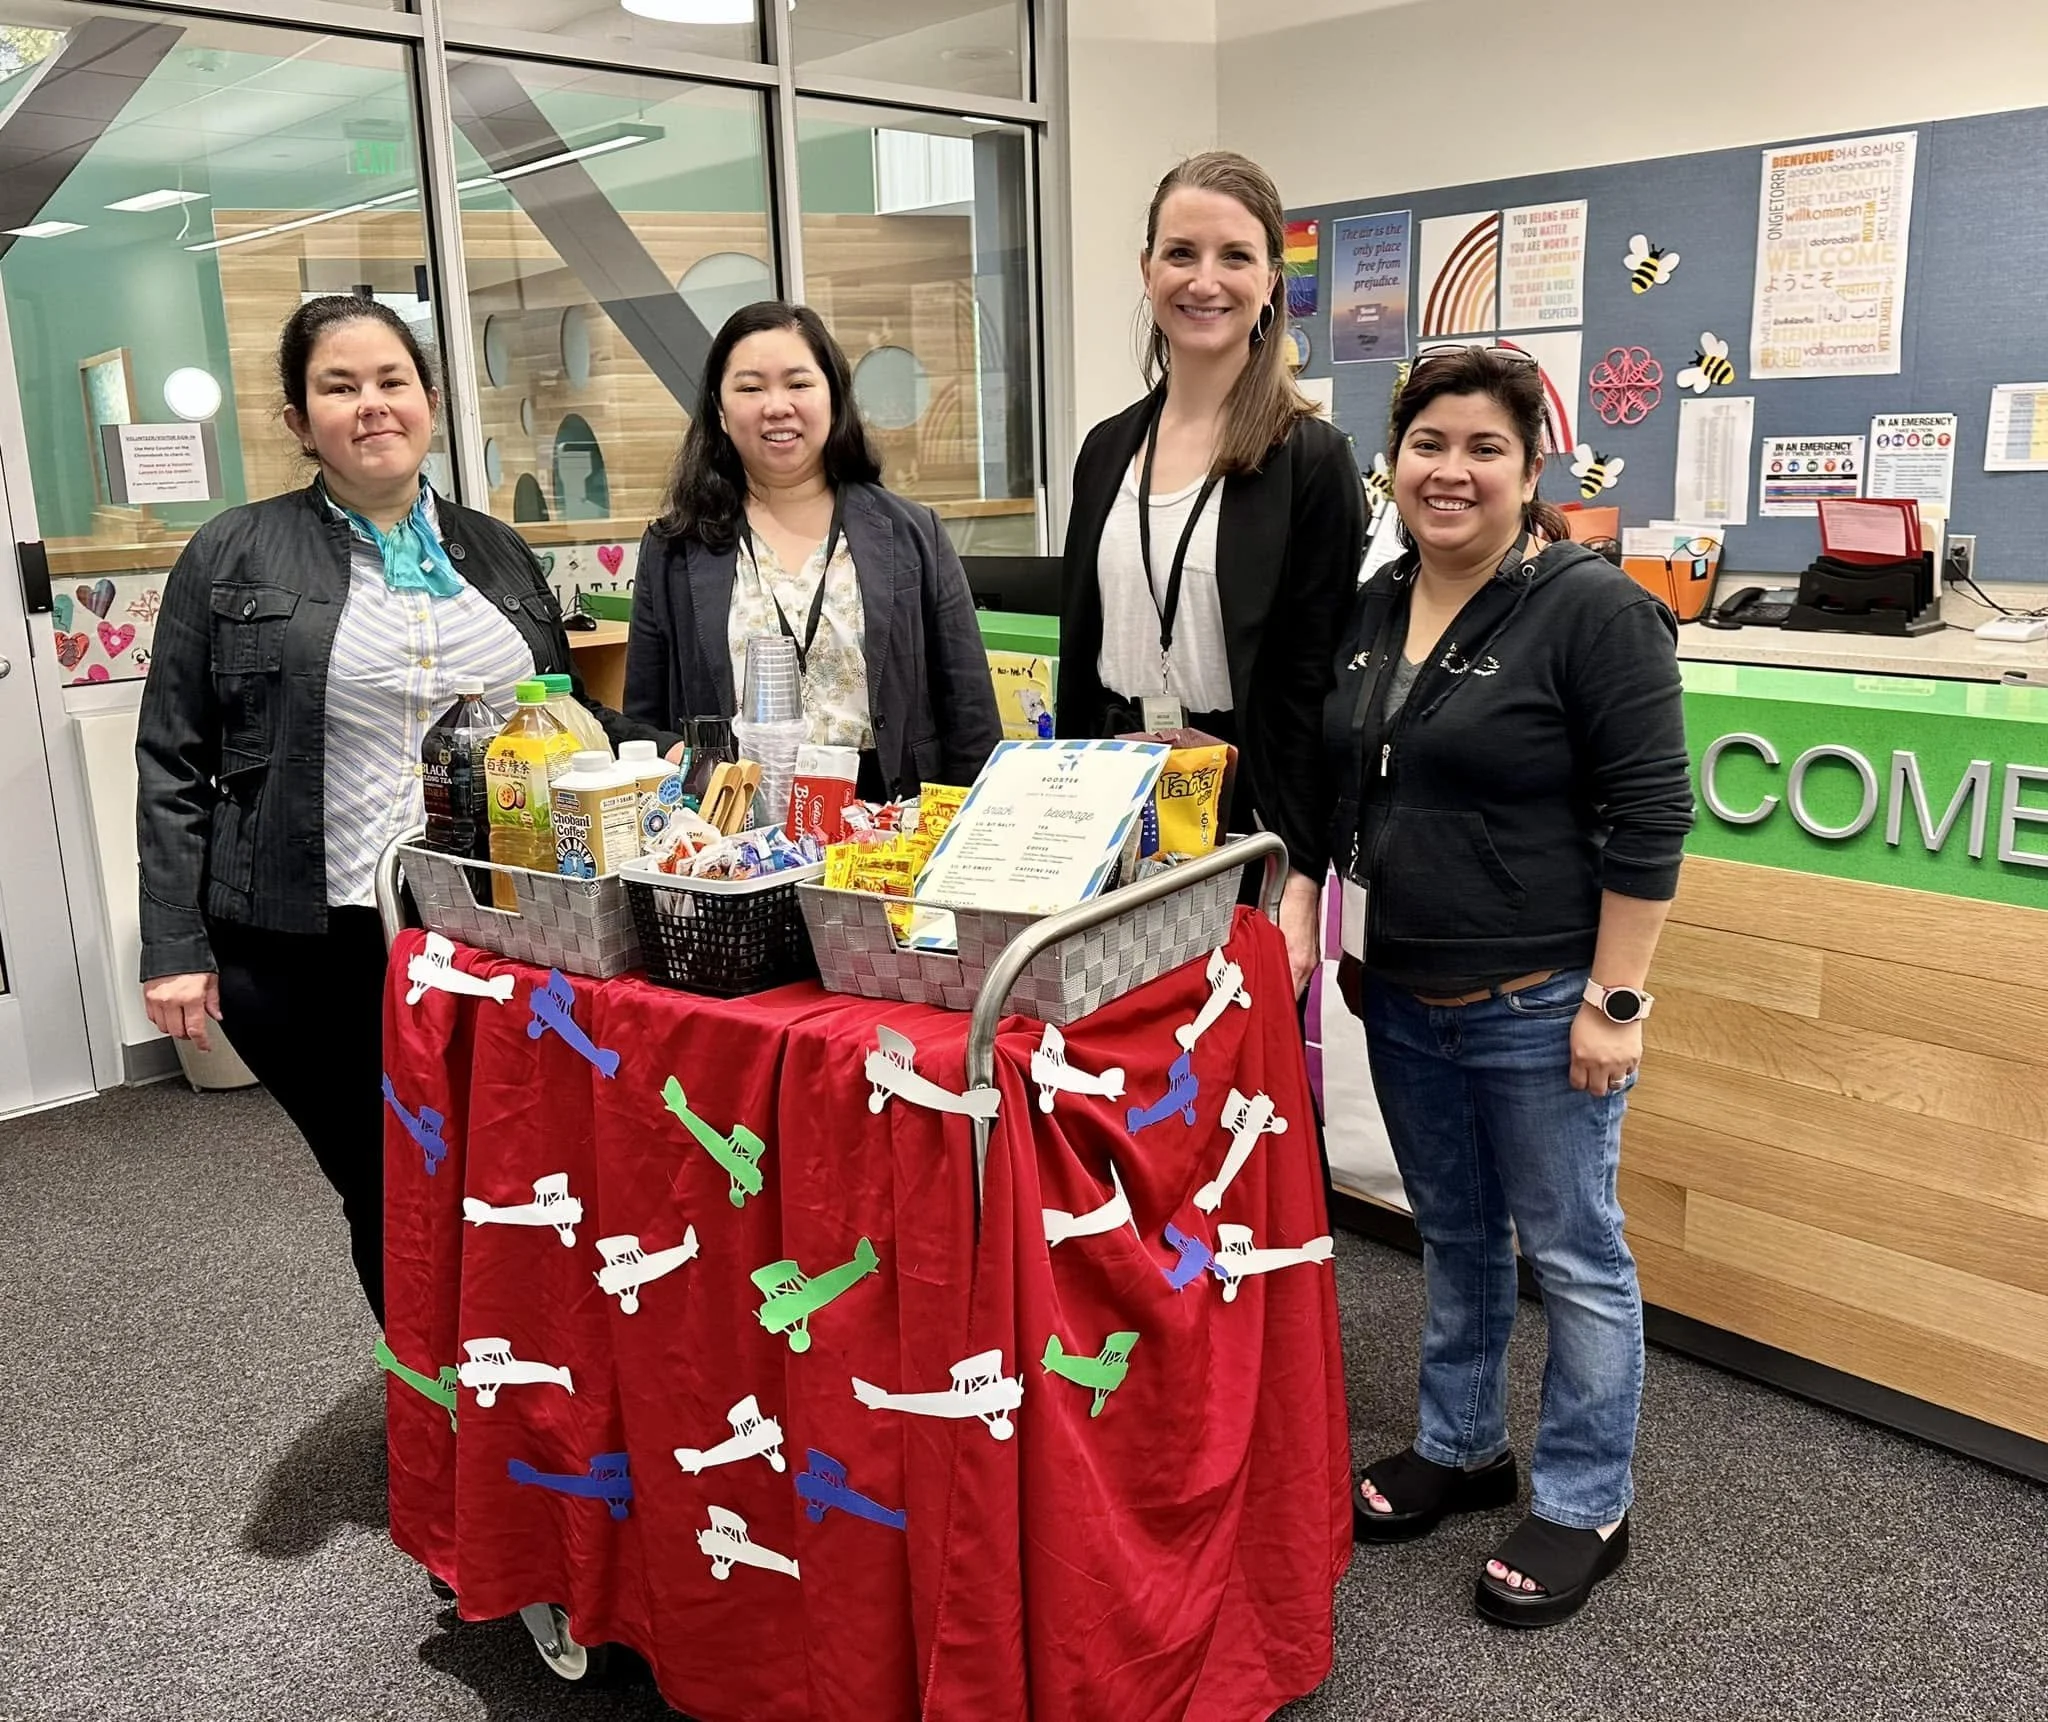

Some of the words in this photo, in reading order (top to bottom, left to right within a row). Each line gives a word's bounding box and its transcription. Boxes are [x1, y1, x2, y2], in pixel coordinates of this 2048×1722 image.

[356, 140, 396, 175] EXIT
[1772, 149, 1834, 168] BIENVENUE
[1768, 170, 1785, 241] ONGIETORRI
[1513, 215, 1527, 225] YOU
[1529, 211, 1558, 224] BELONG
[1560, 208, 1580, 220] HERE
[1341, 229, 1357, 241] The
[1359, 228, 1373, 239] air
[1375, 225, 1384, 236] is
[1386, 223, 1402, 235] the
[1523, 228, 1537, 238] YOU
[1539, 224, 1567, 236] MATTER
[1353, 243, 1373, 258] only
[1375, 241, 1402, 257] place
[1510, 243, 1525, 253] YOU
[1527, 241, 1541, 251] ARE
[1543, 238, 1569, 250] WORTH
[1571, 236, 1579, 247] IT
[1539, 251, 1580, 264] IMPORTANT
[1767, 242, 1896, 272] WELCOME
[1356, 260, 1376, 275] free
[1376, 259, 1401, 274] from
[1354, 275, 1400, 293] prejudice.
[1510, 284, 1525, 294] YOU
[1526, 282, 1544, 293] HAVE
[1553, 279, 1575, 291] VOICE
[1764, 271, 1835, 293] ようこそ
[1512, 297, 1527, 308] YOU
[1529, 296, 1542, 307] ARE
[1538, 307, 1578, 320] RESPECTED
[1878, 418, 1885, 426] IN
[1888, 418, 1899, 426] AN
[1901, 417, 1952, 427] EMERGENCY
[1775, 443, 1783, 451] IN
[1786, 443, 1797, 451] AN
[1800, 441, 1852, 451] EMERGENCY
[421, 762, 448, 777] BLACK
[440, 777, 452, 785] TEA
[1041, 776, 1079, 784] BOOSTER
[1701, 732, 2048, 868] COME
[553, 812, 590, 827] Chobani
[813, 800, 823, 825] Lotus
[1043, 807, 1096, 824] beverage
[557, 825, 585, 839] Coffee
